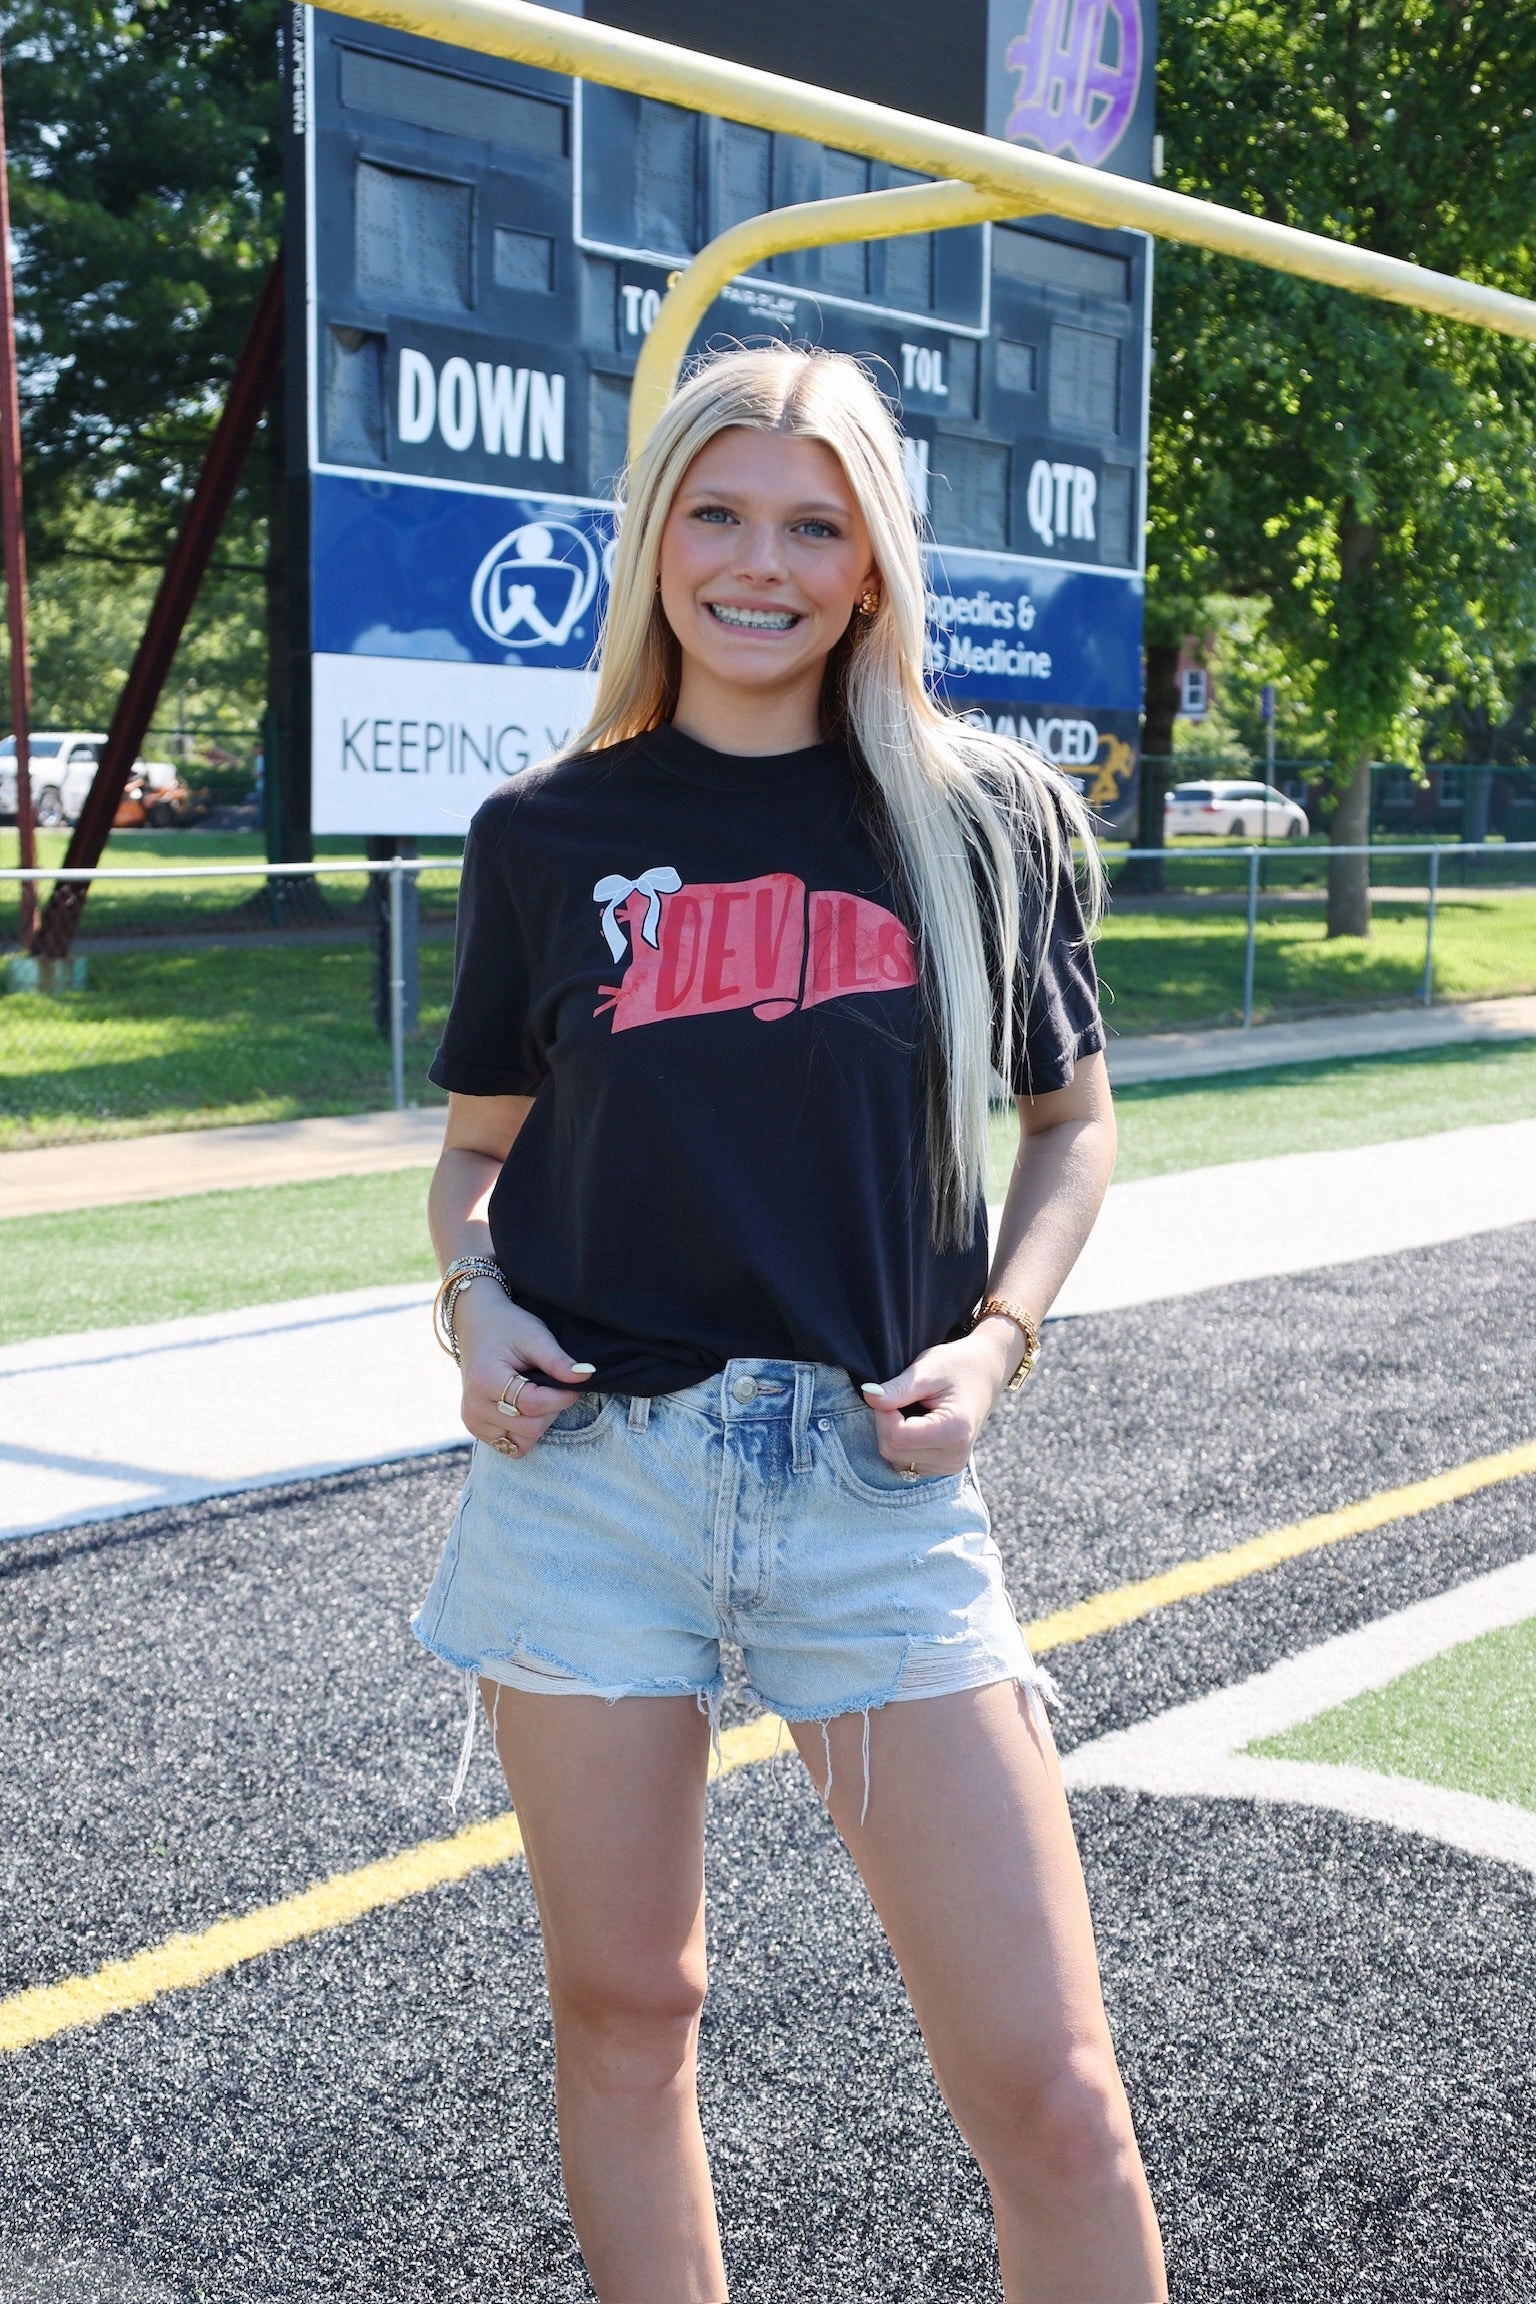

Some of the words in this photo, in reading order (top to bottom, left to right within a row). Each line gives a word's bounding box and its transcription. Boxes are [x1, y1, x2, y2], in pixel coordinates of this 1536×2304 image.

[621, 284, 662, 337] TO
[901, 342, 949, 396] TOL
[399, 347, 565, 464] DOWN
[1026, 459, 1097, 547] QTR
[925, 590, 1015, 630] opedics
[1017, 594, 1037, 632] &
[950, 634, 1053, 680] Medicine
[341, 717, 530, 776] KEEPING
[655, 884, 917, 1012] DEVILS
